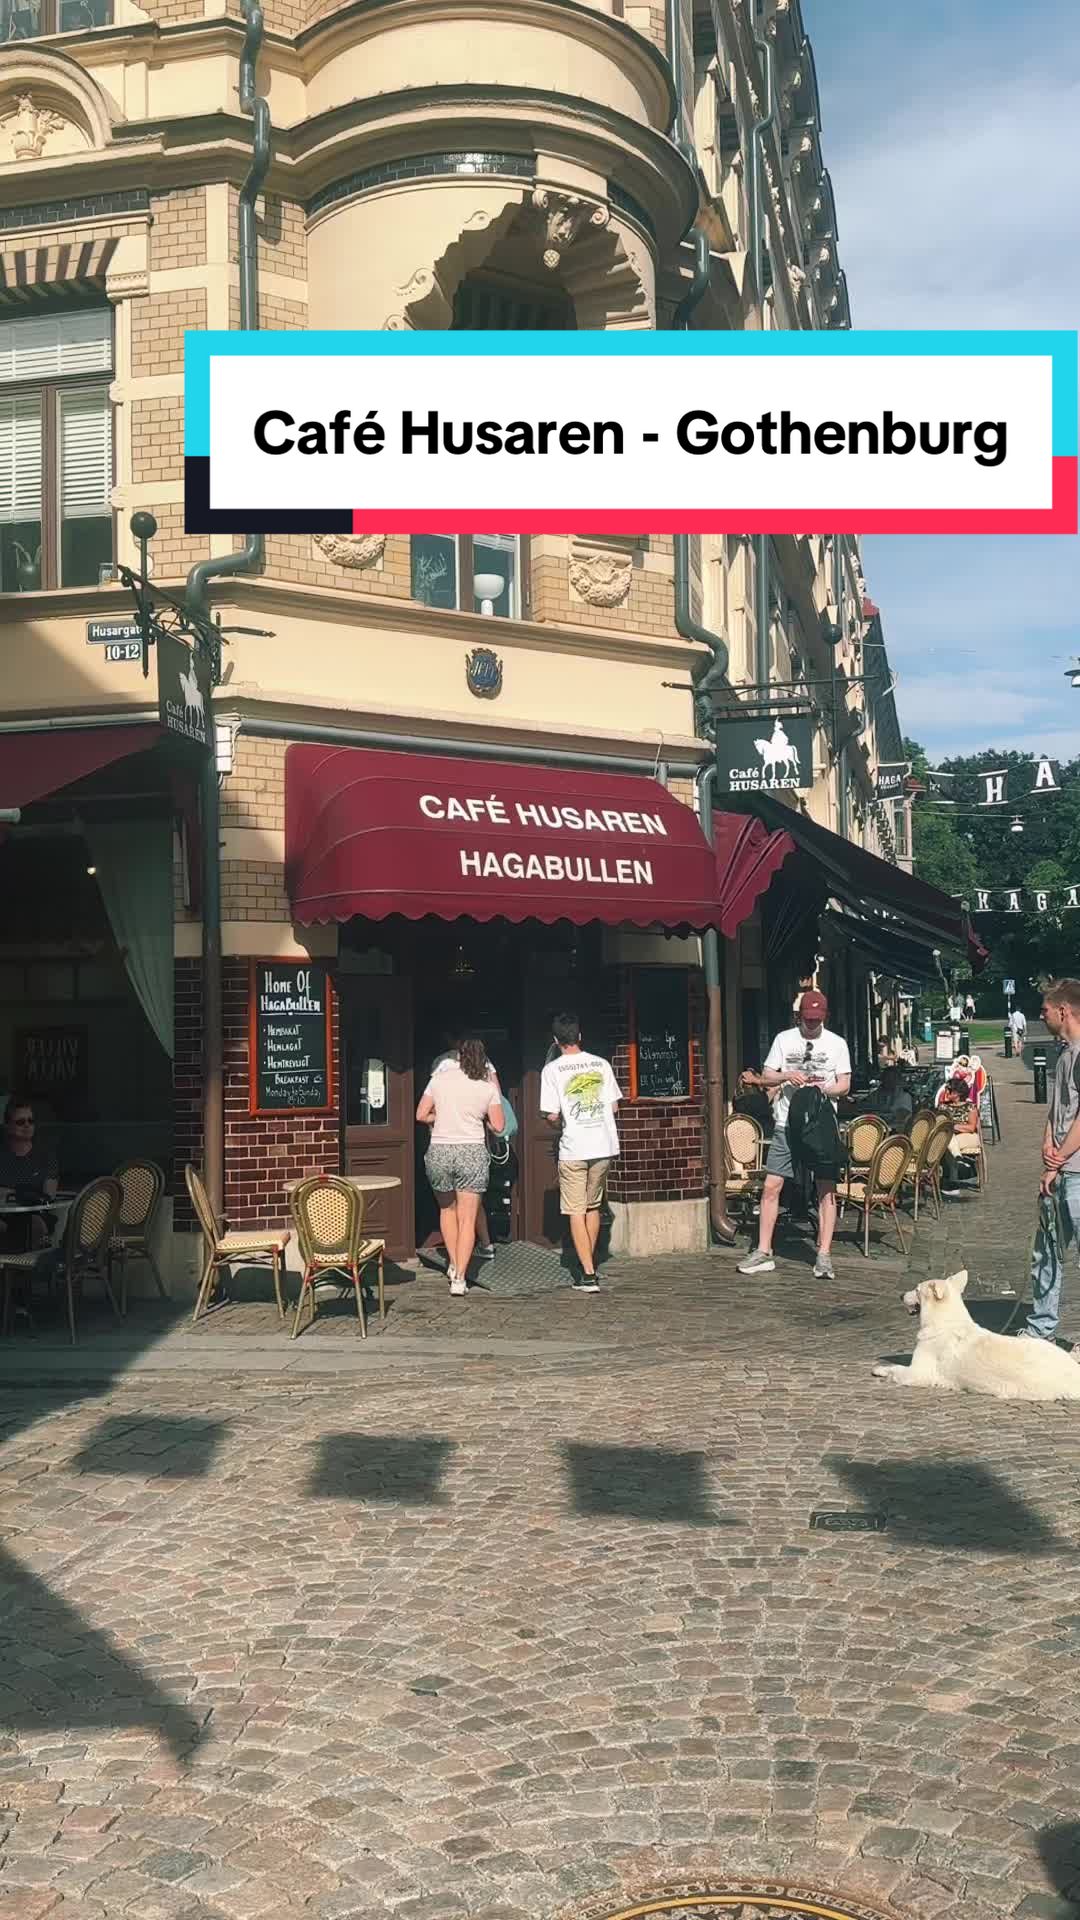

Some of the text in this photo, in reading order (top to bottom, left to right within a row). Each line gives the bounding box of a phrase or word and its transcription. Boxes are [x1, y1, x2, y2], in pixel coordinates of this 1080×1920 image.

[105, 644, 140, 660] 10-12
[167, 715, 206, 743] HUSAREN
[728, 768, 760, 779] Café
[878, 774, 902, 786] HAGA
[729, 778, 800, 791] HUSAREN
[419, 794, 668, 836] CAFÉ HUSAREN
[459, 850, 654, 885] HAGABULLEN
